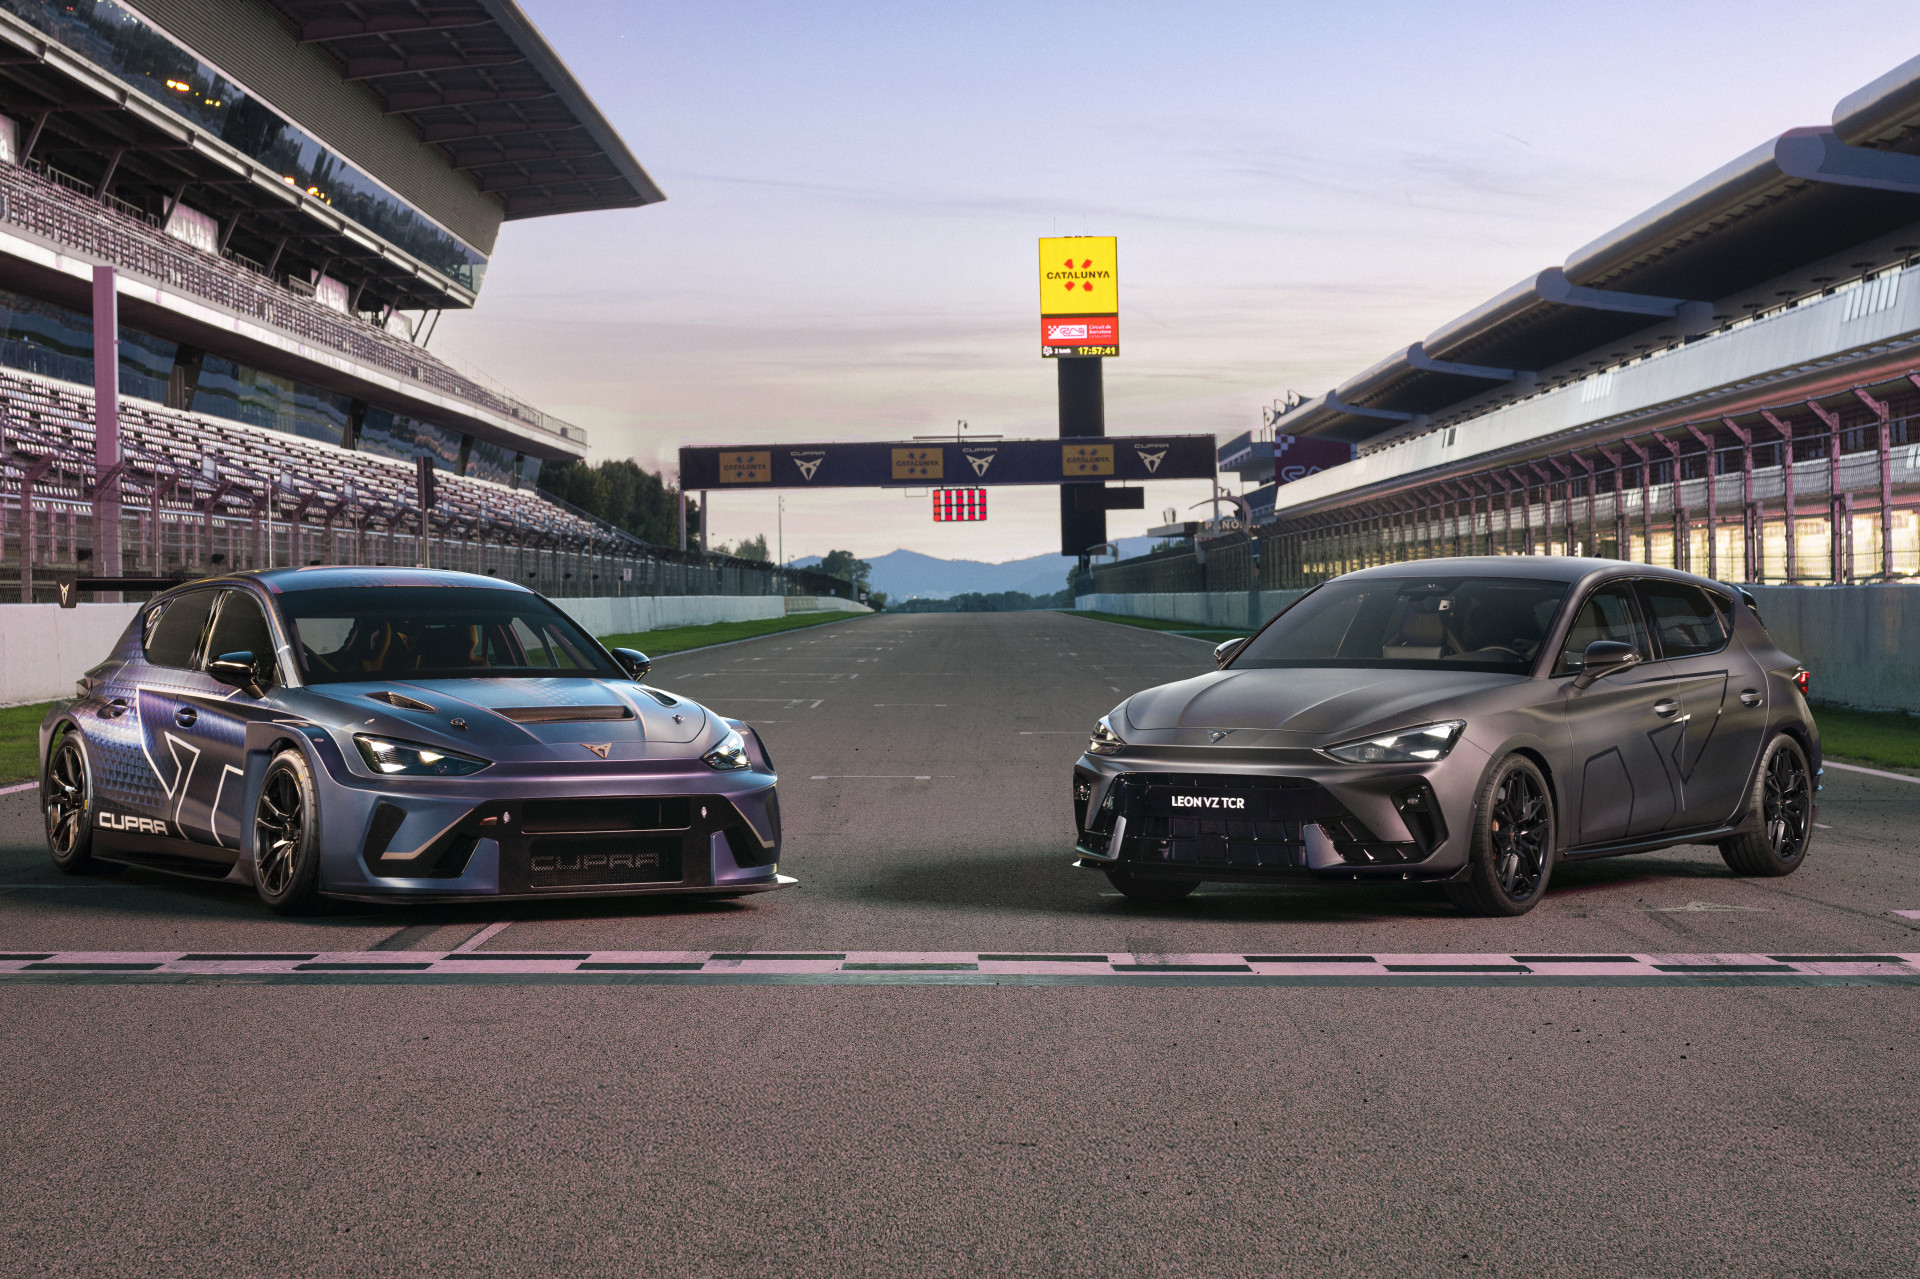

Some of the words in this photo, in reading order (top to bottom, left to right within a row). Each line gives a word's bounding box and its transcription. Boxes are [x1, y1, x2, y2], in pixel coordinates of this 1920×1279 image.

[1047, 271, 1110, 279] CATALUNYA
[1078, 346, 1116, 355] 17:57:41
[724, 463, 767, 471] CATALUNYA
[1171, 795, 1203, 808] LEON
[1203, 796, 1220, 808] VZ
[1221, 797, 1245, 809] TCR
[99, 811, 169, 836] CUPRA
[531, 853, 660, 871] CUPRA
